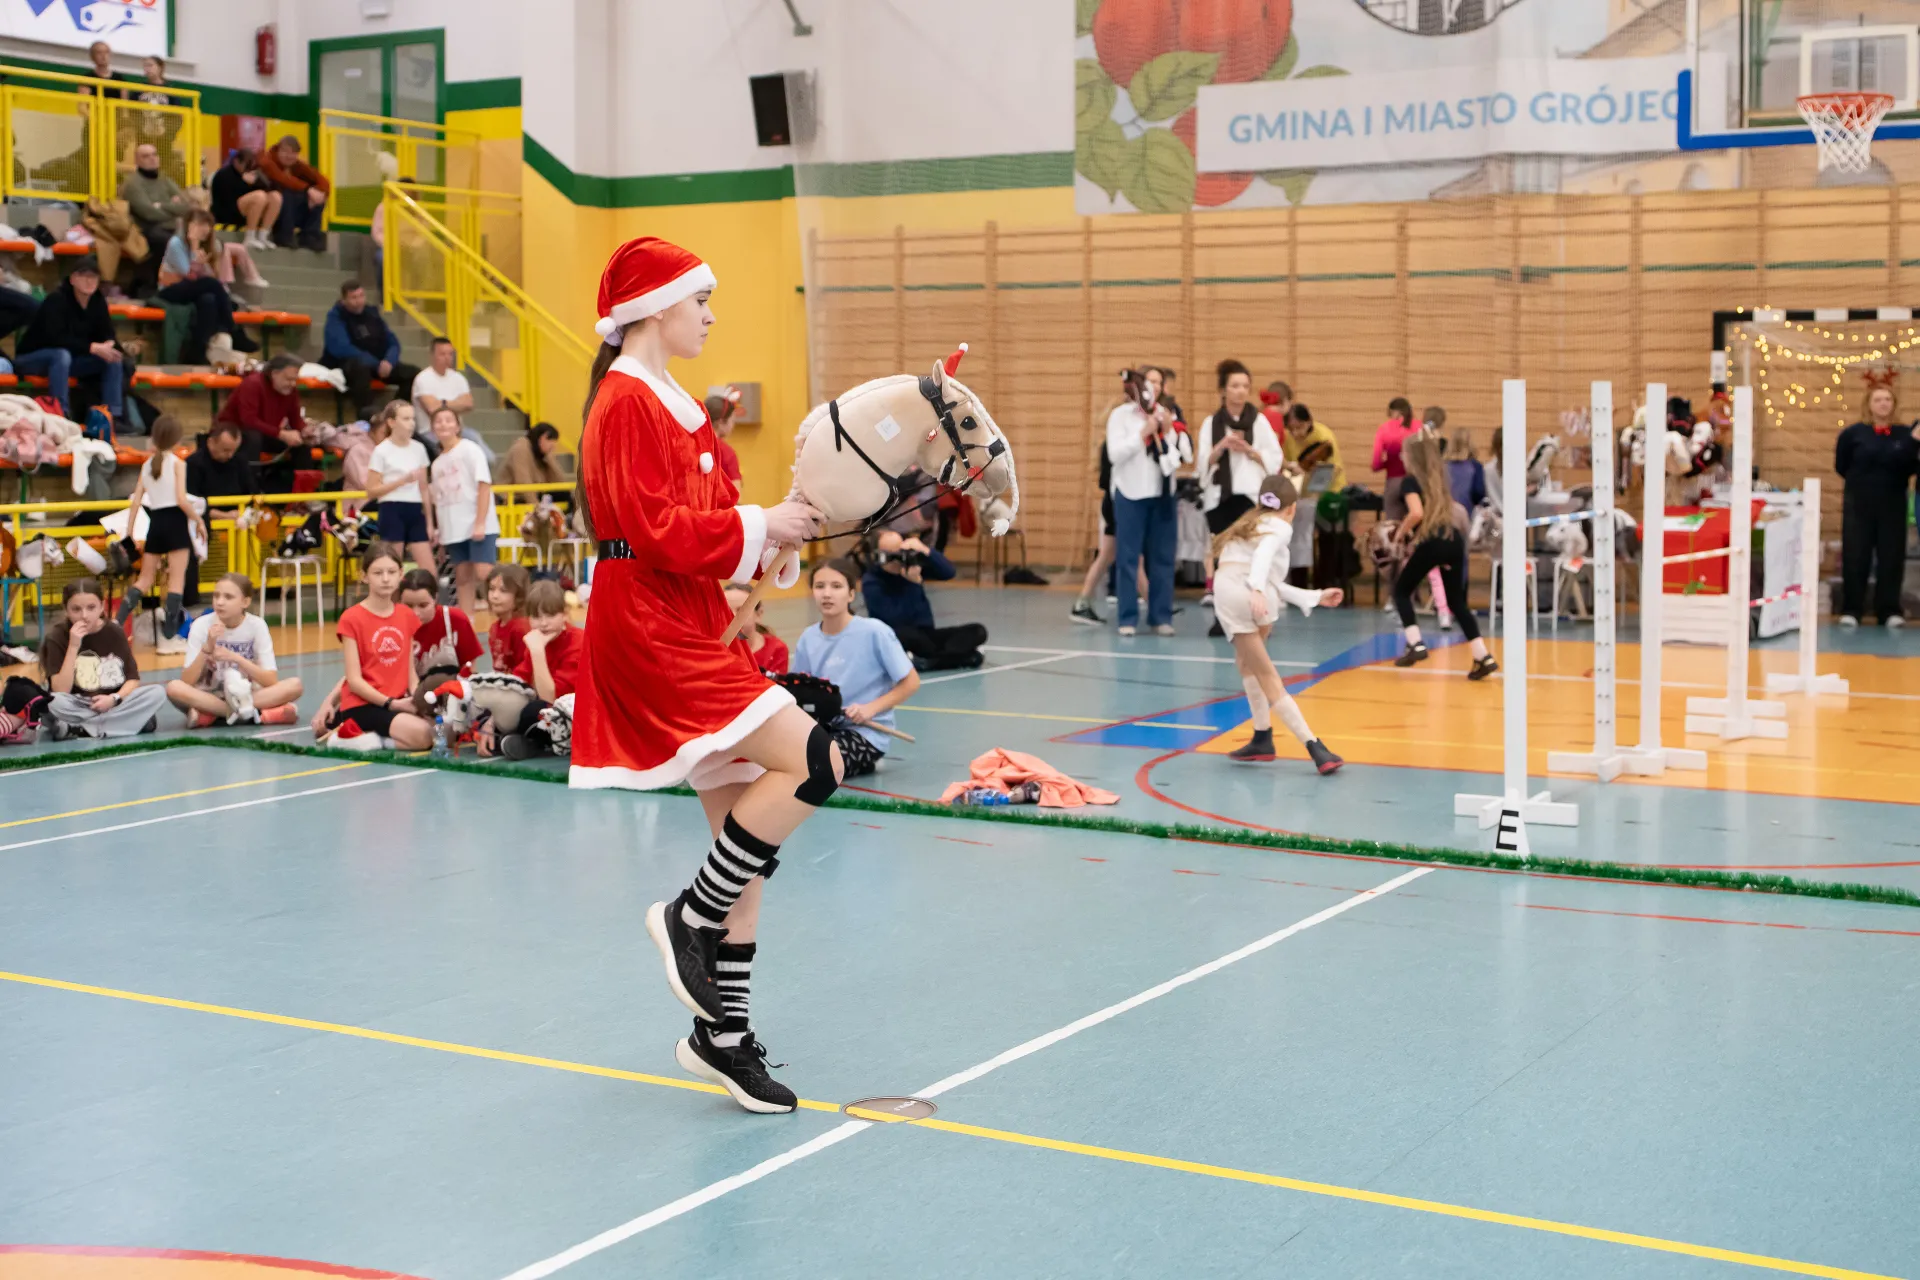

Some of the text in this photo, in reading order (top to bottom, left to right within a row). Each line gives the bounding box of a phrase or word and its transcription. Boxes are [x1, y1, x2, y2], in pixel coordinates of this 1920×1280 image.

[1228, 107, 1353, 143] GMINA
[1363, 106, 1372, 136] I
[1384, 91, 1517, 134] MIASTO
[1496, 809, 1519, 851] E
